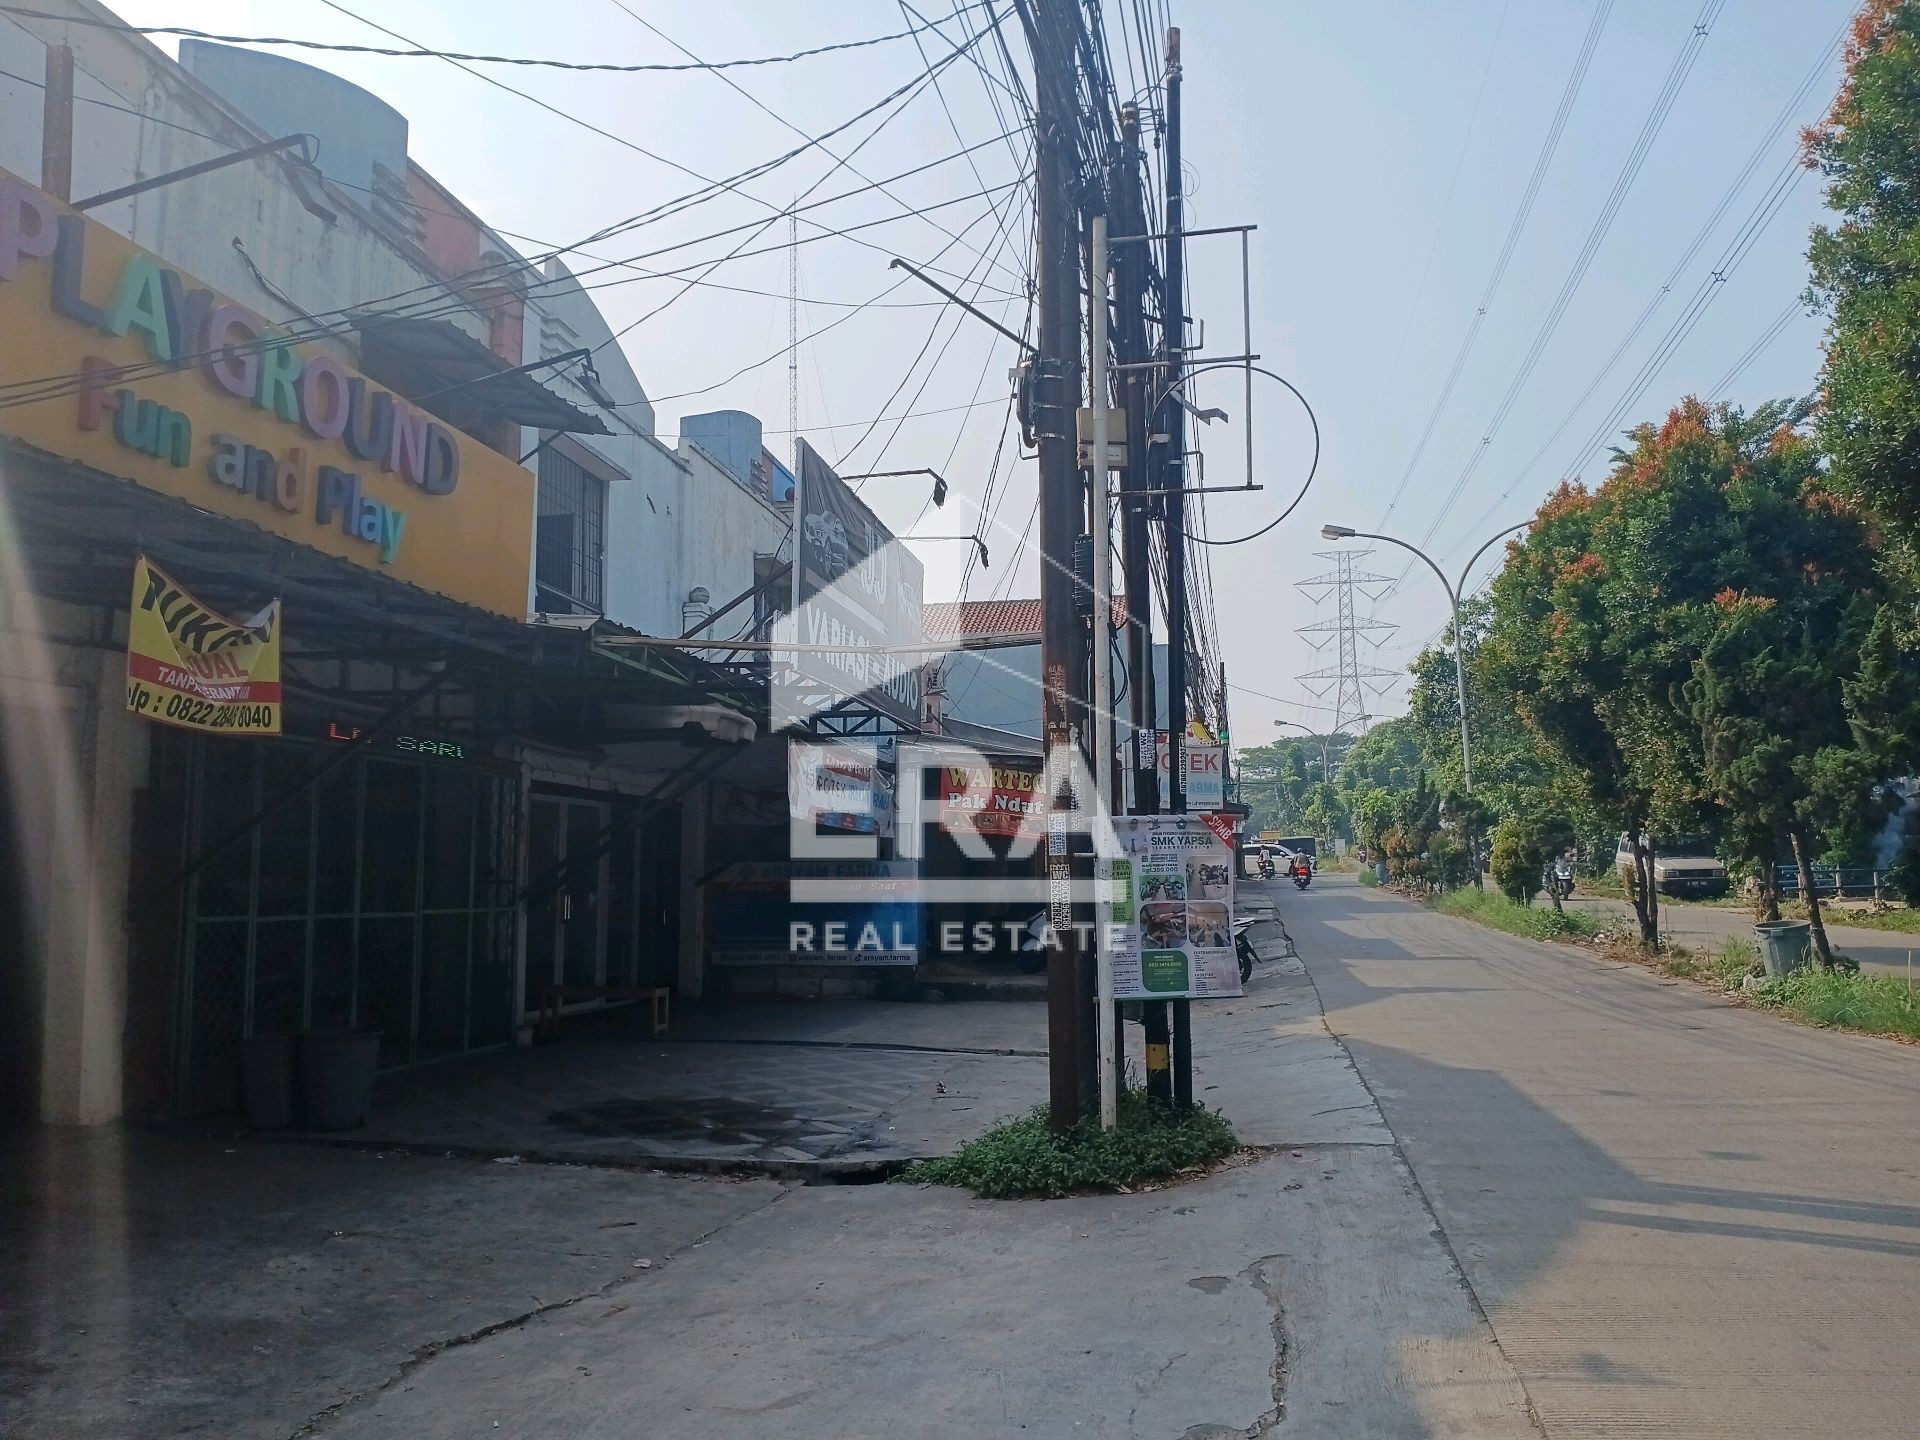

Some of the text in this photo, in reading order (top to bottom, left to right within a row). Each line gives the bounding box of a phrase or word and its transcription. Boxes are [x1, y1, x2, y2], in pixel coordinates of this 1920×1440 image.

[0, 176, 459, 496] PLAYGROUND
[78, 357, 405, 565] Fun and Play
[882, 653, 918, 710] AUDIO
[166, 694, 215, 725] 0822
[238, 705, 272, 728] 8040
[948, 766, 1046, 795] WARTEG
[948, 792, 1044, 815] Pak Ndut
[1151, 836, 1213, 846] SMK YAPSA
[1209, 815, 1232, 840] SPMB
